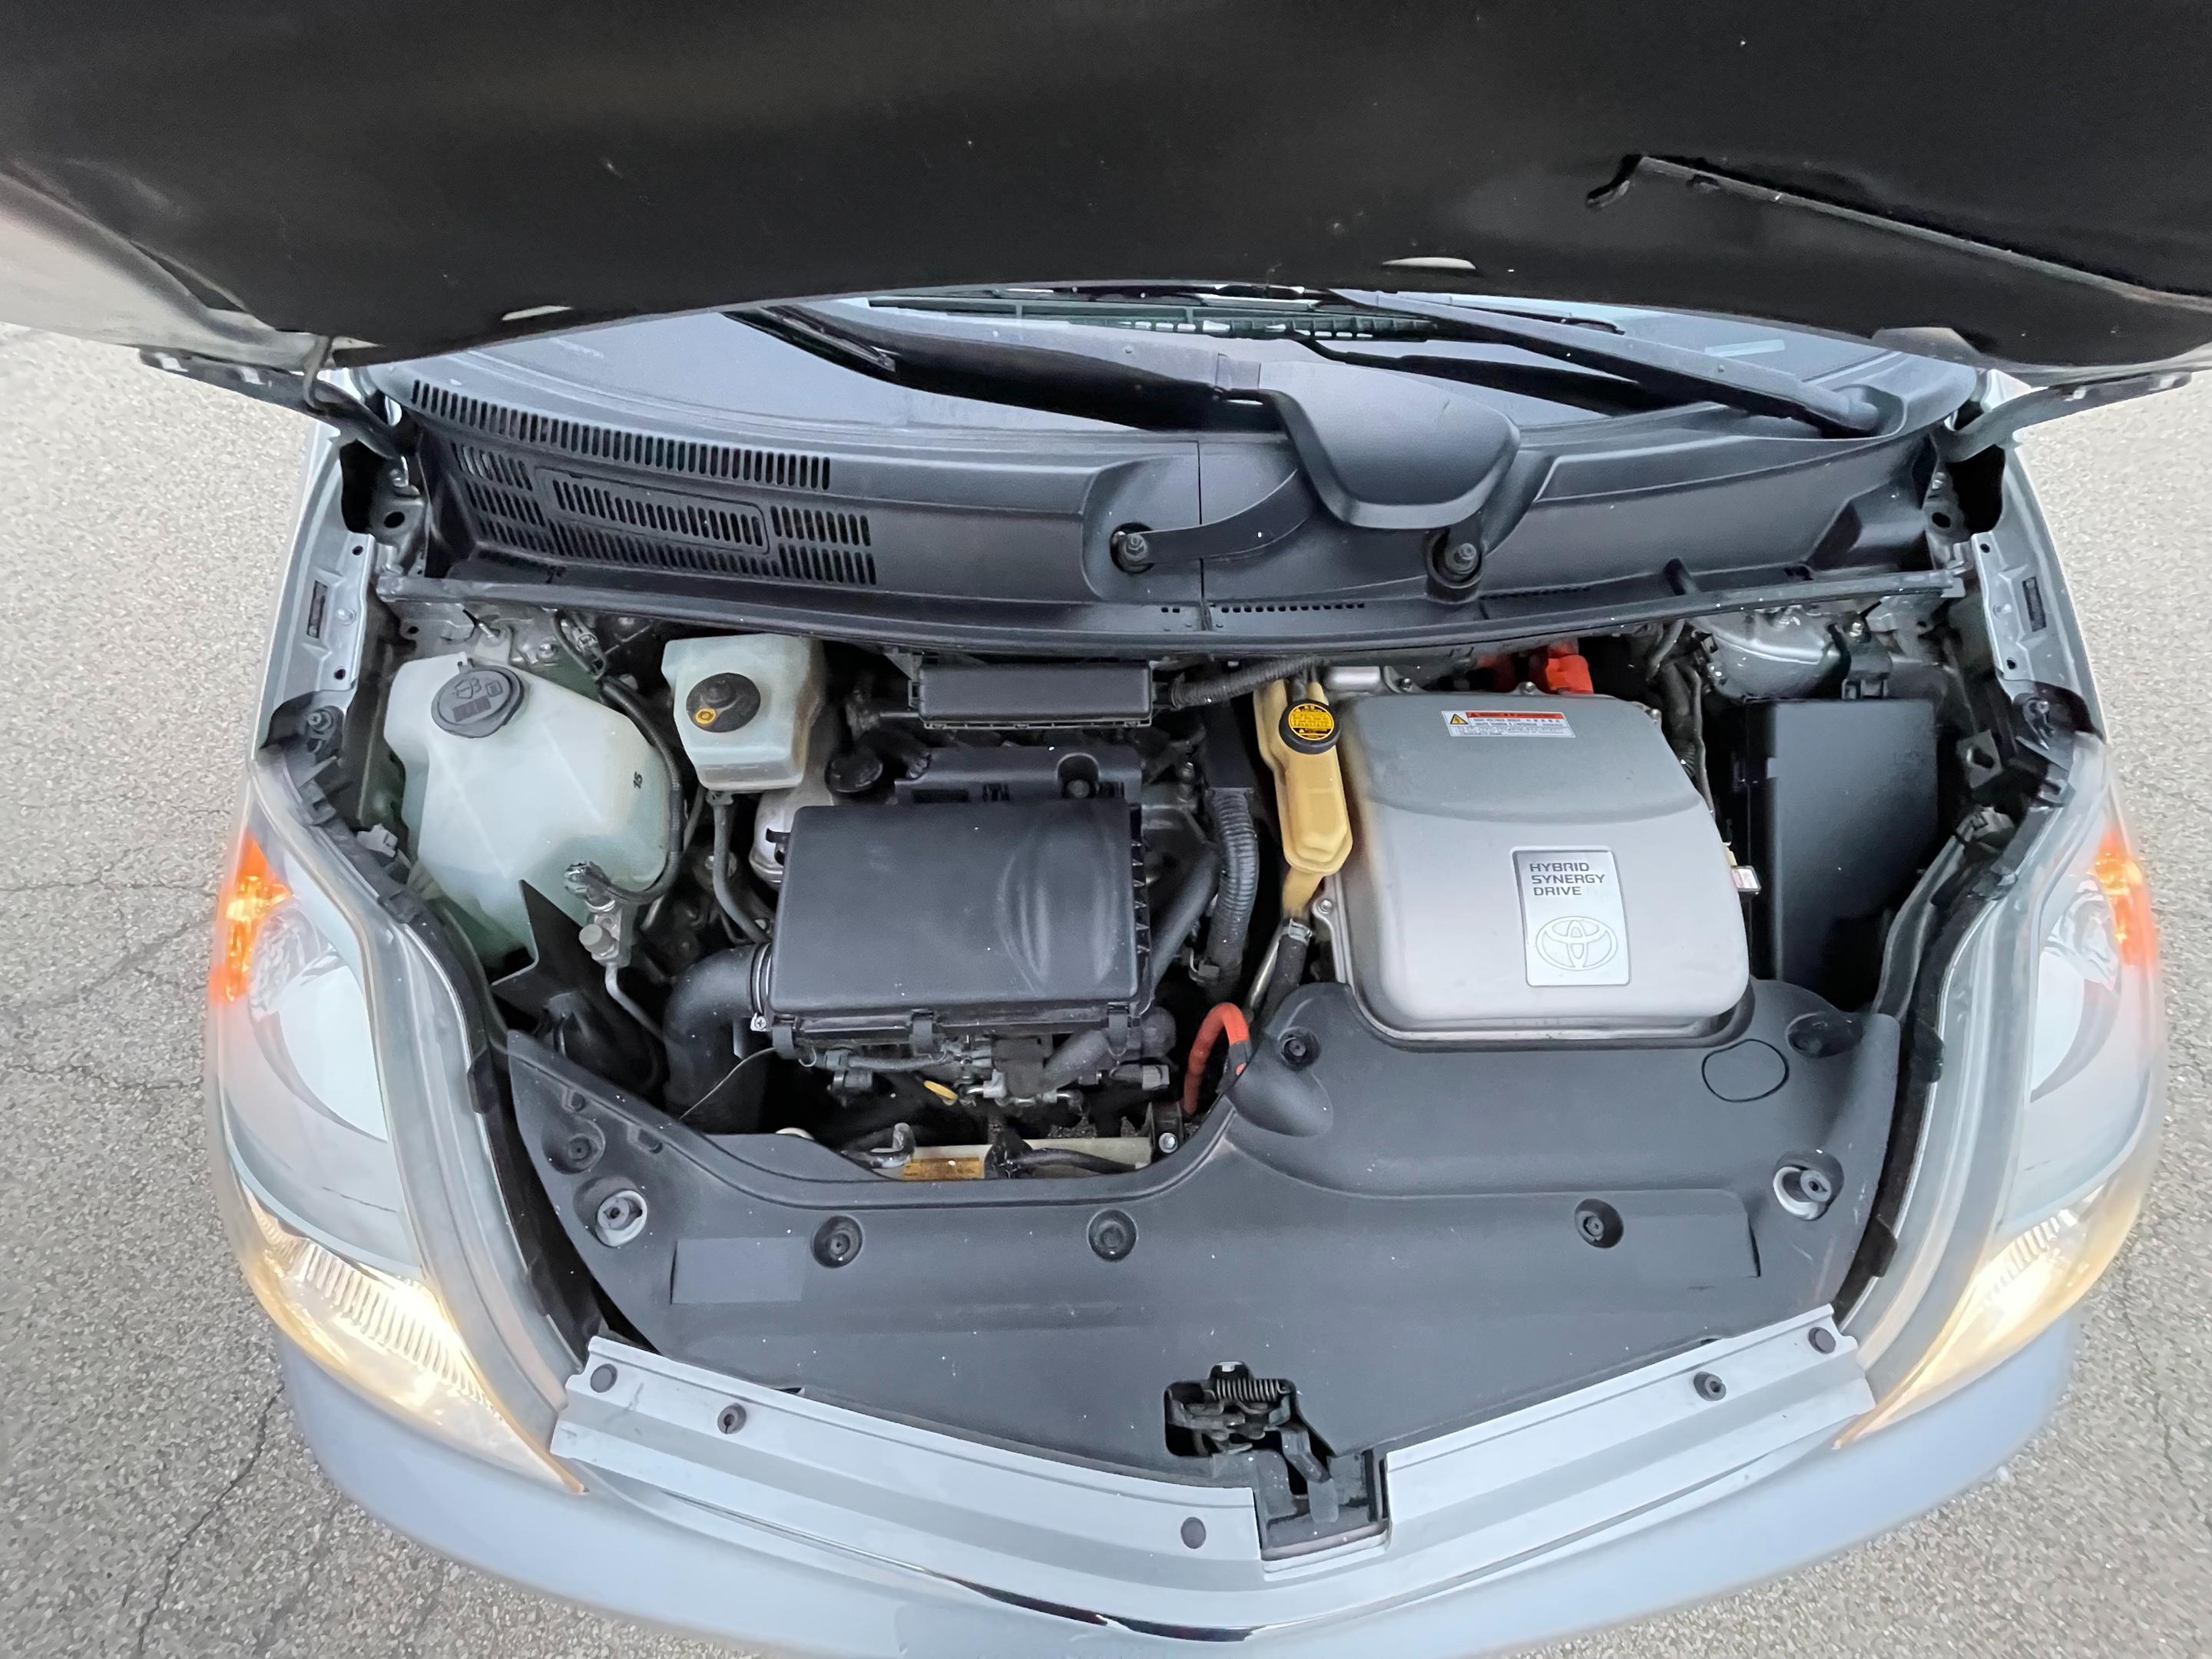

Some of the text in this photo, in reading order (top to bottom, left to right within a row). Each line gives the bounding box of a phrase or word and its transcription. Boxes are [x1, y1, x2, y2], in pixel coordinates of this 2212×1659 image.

[1529, 863, 1590, 872] HYBRID
[1532, 874, 1605, 884] SYNERGY
[1533, 886, 1582, 896] DRIVE
